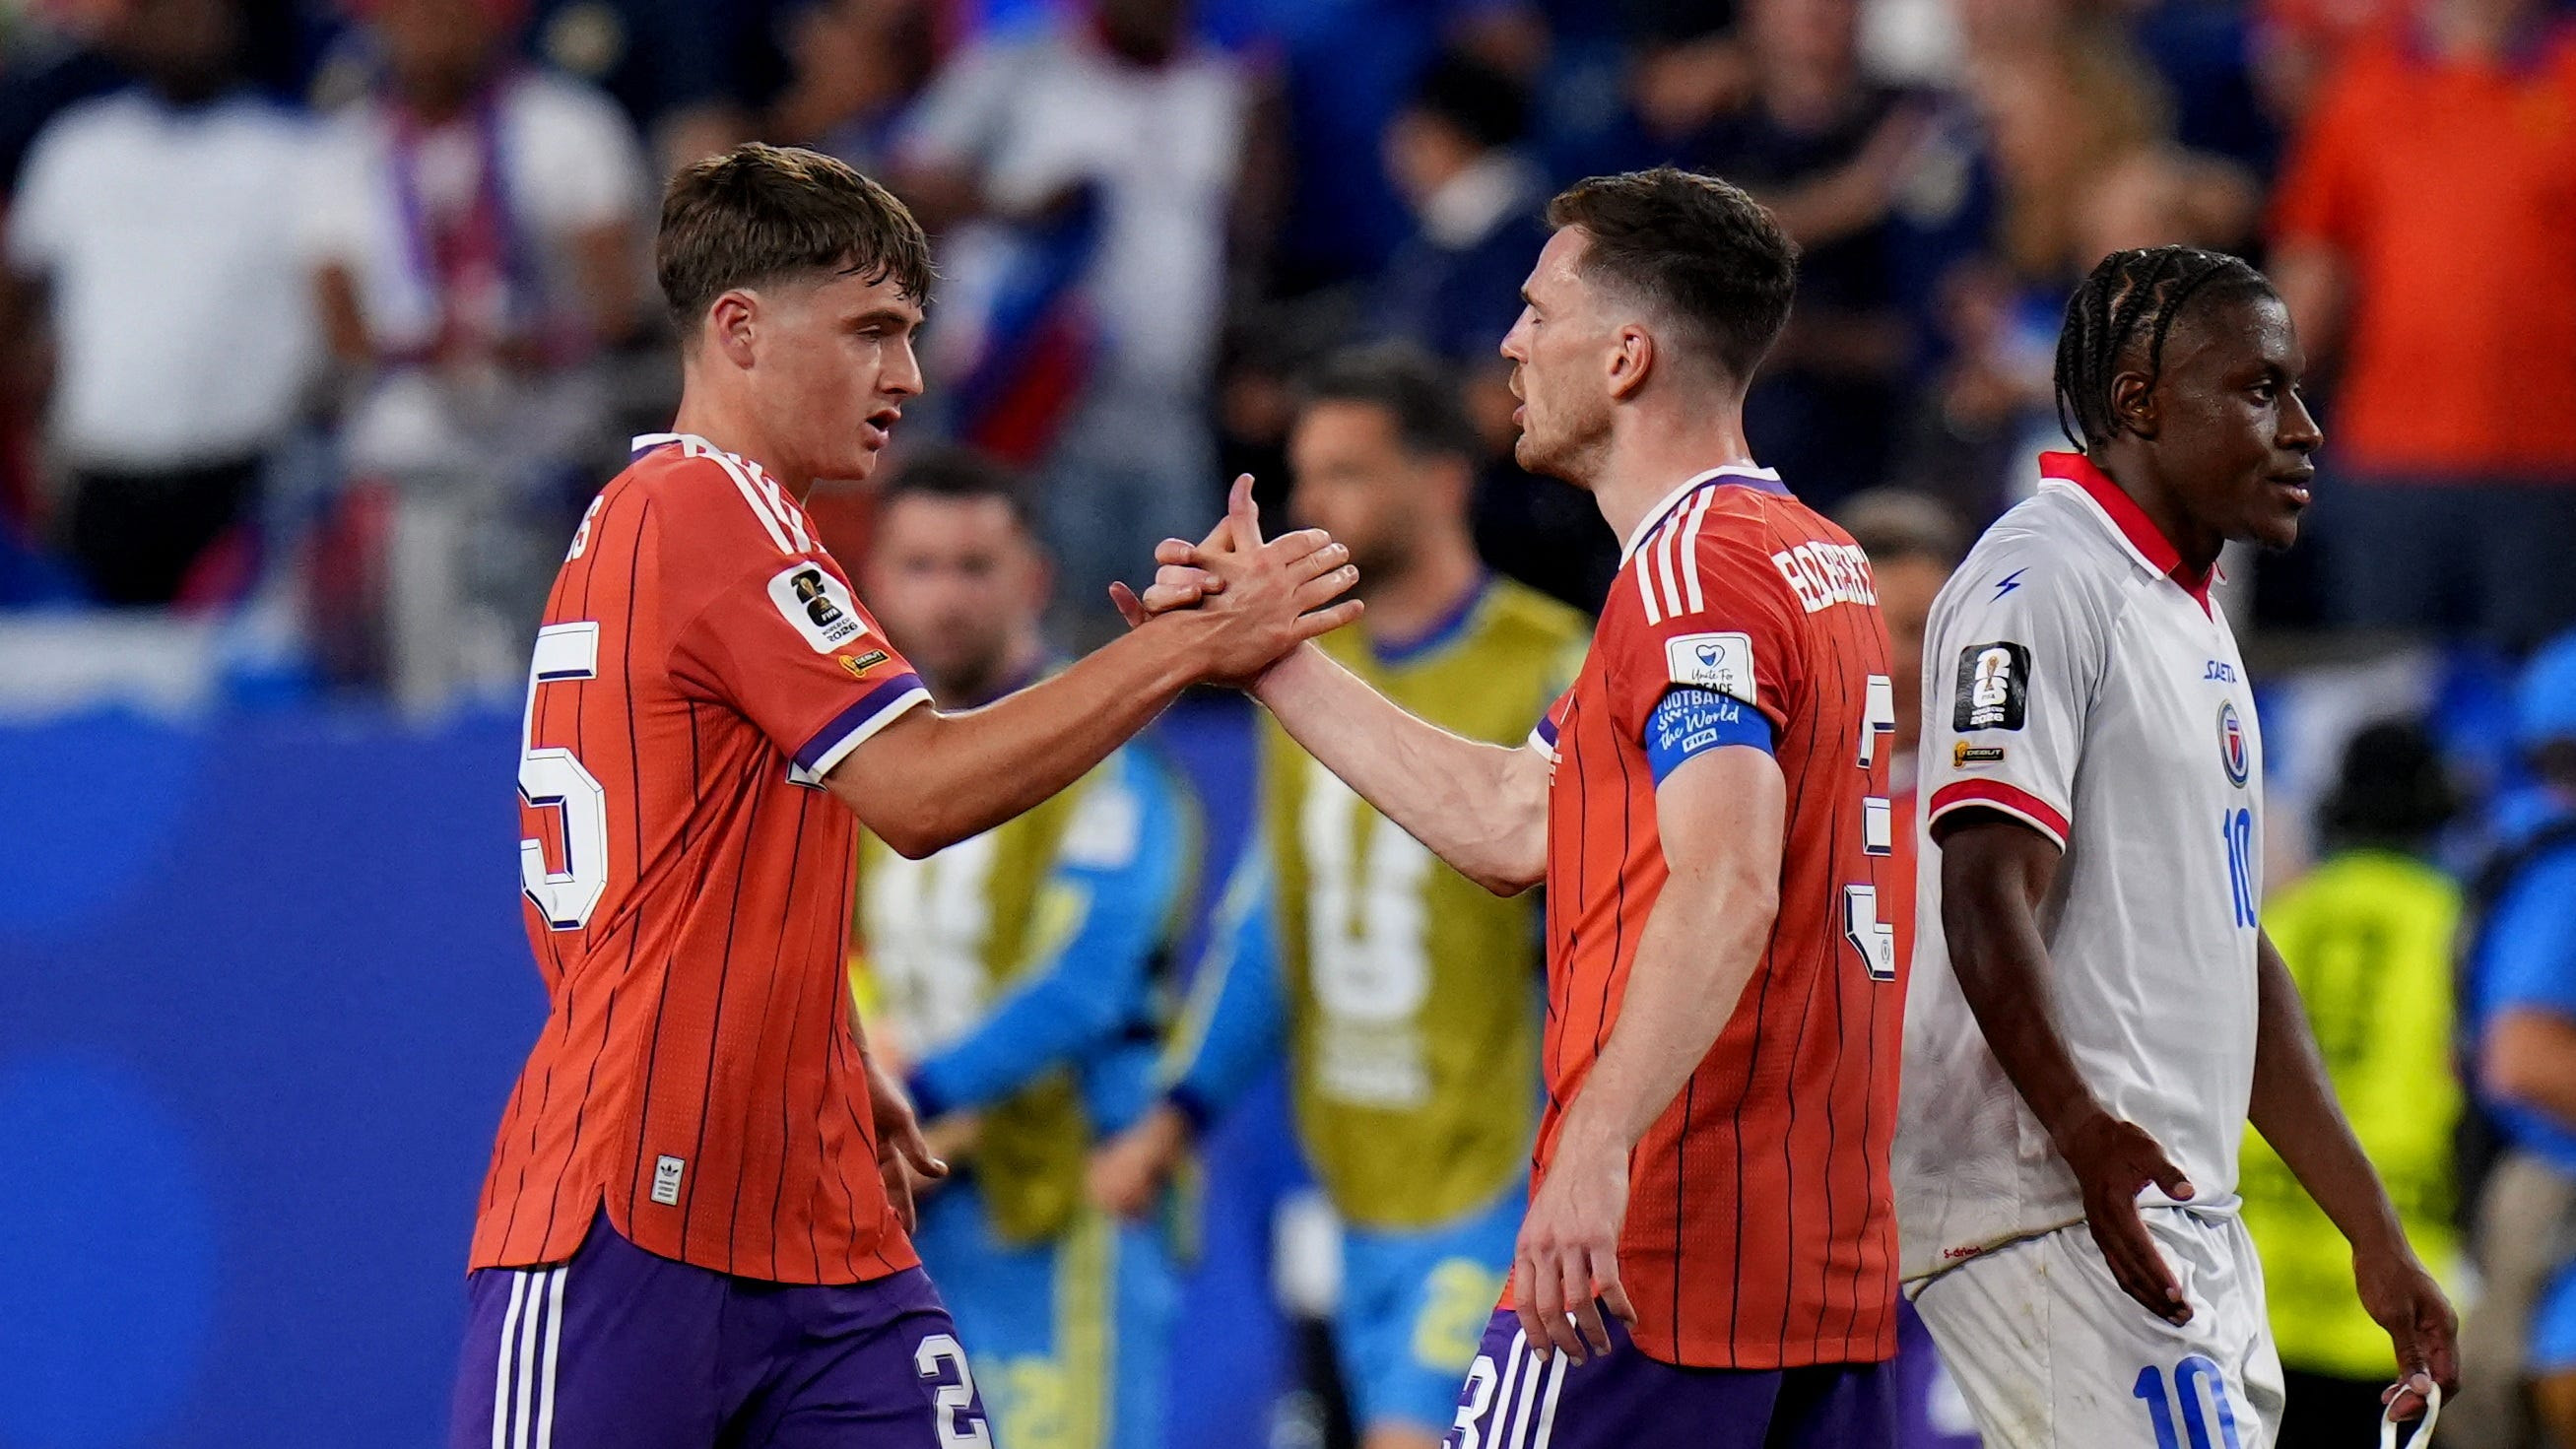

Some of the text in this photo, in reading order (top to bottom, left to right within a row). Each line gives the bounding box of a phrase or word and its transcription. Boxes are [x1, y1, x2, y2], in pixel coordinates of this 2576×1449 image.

[827, 622, 859, 641] 2026
[2204, 660, 2237, 684] SAETA
[1659, 727, 1684, 751] the
[1684, 703, 1740, 733] World
[1970, 712, 2005, 725] 2026
[1684, 731, 1715, 750] FIFA
[2223, 808, 2256, 928] 10
